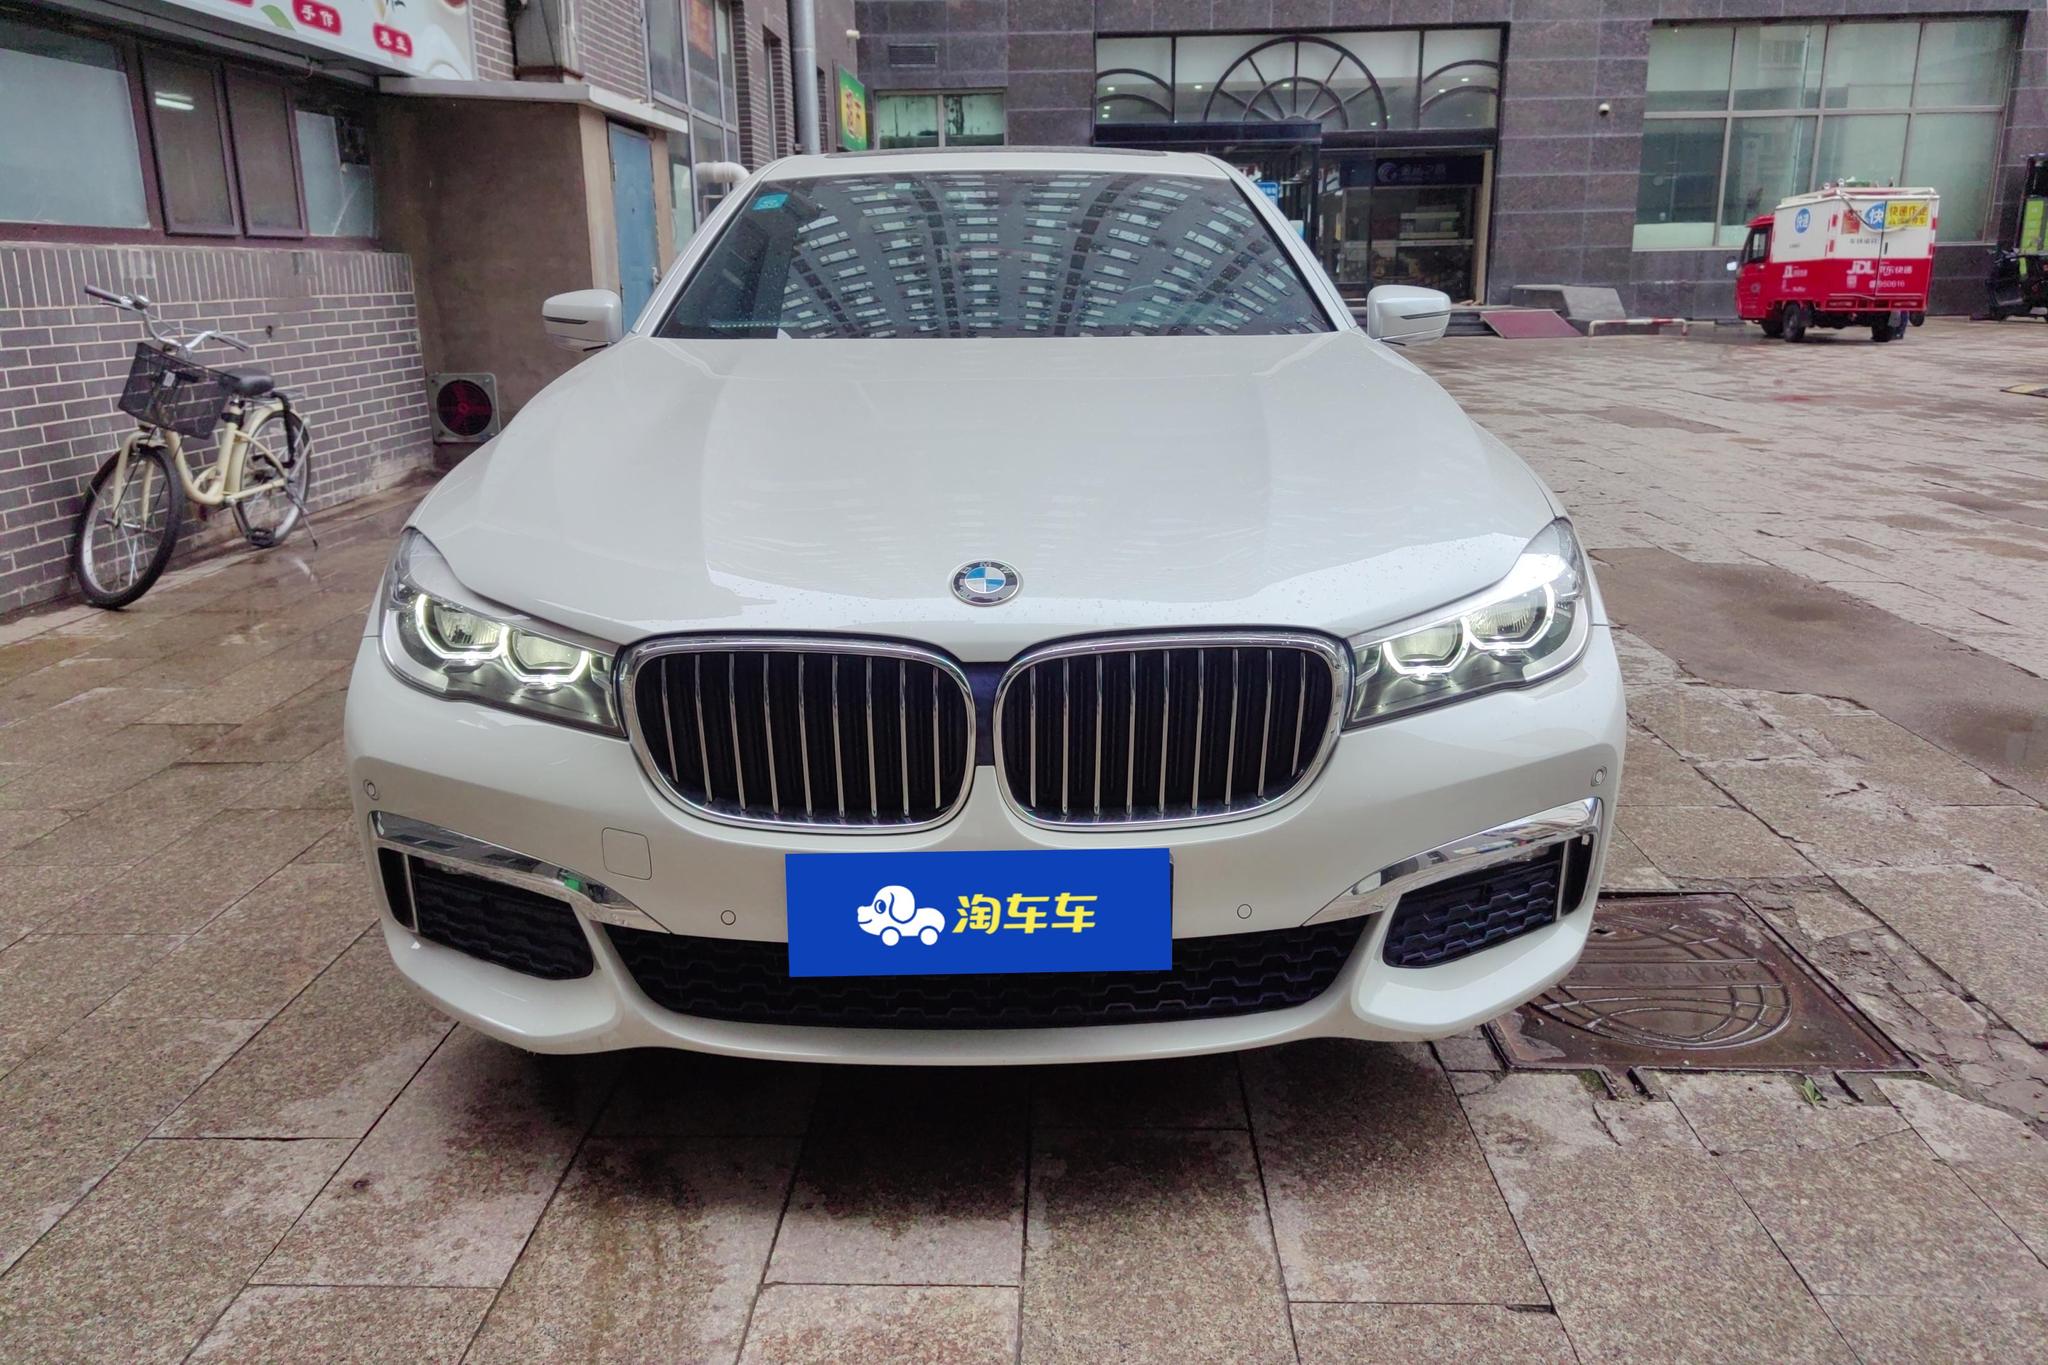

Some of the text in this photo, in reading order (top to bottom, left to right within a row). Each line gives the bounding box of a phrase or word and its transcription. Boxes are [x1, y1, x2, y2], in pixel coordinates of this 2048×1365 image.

[301, 5, 334, 28] 手作
[1846, 260, 1875, 275] JDL
[961, 561, 1015, 576] BMW
